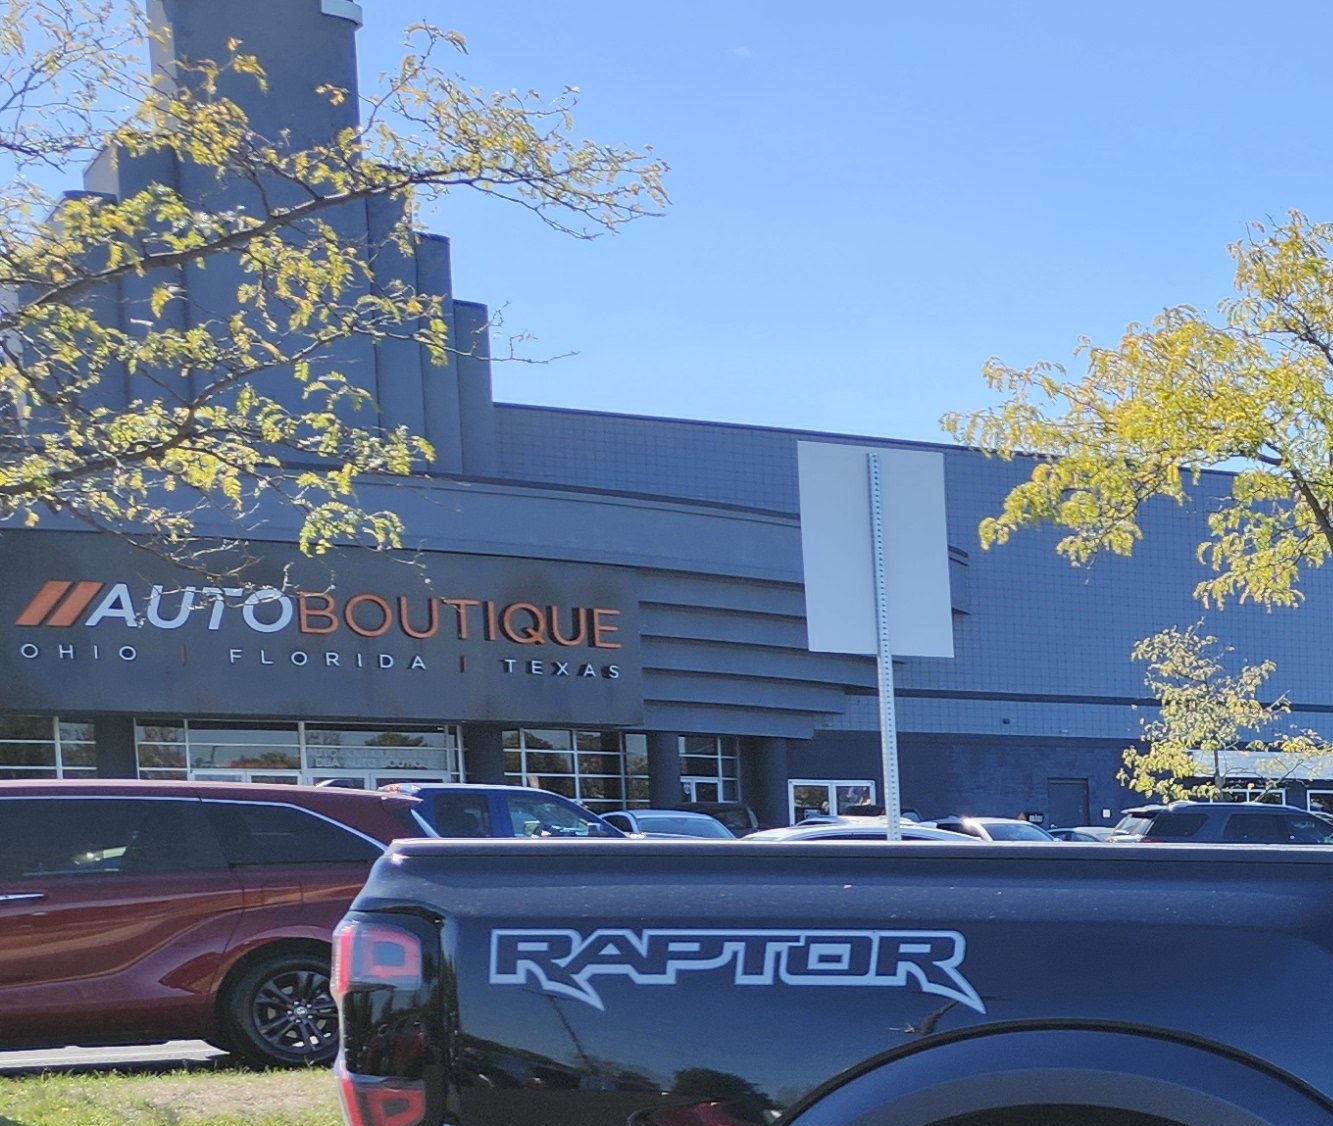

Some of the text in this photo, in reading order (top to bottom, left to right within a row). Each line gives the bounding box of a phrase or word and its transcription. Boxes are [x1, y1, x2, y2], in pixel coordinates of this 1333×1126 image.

[20, 643, 620, 679] OHIO FLORIDA TEXAS
[489, 928, 986, 1014] RAPTOR
